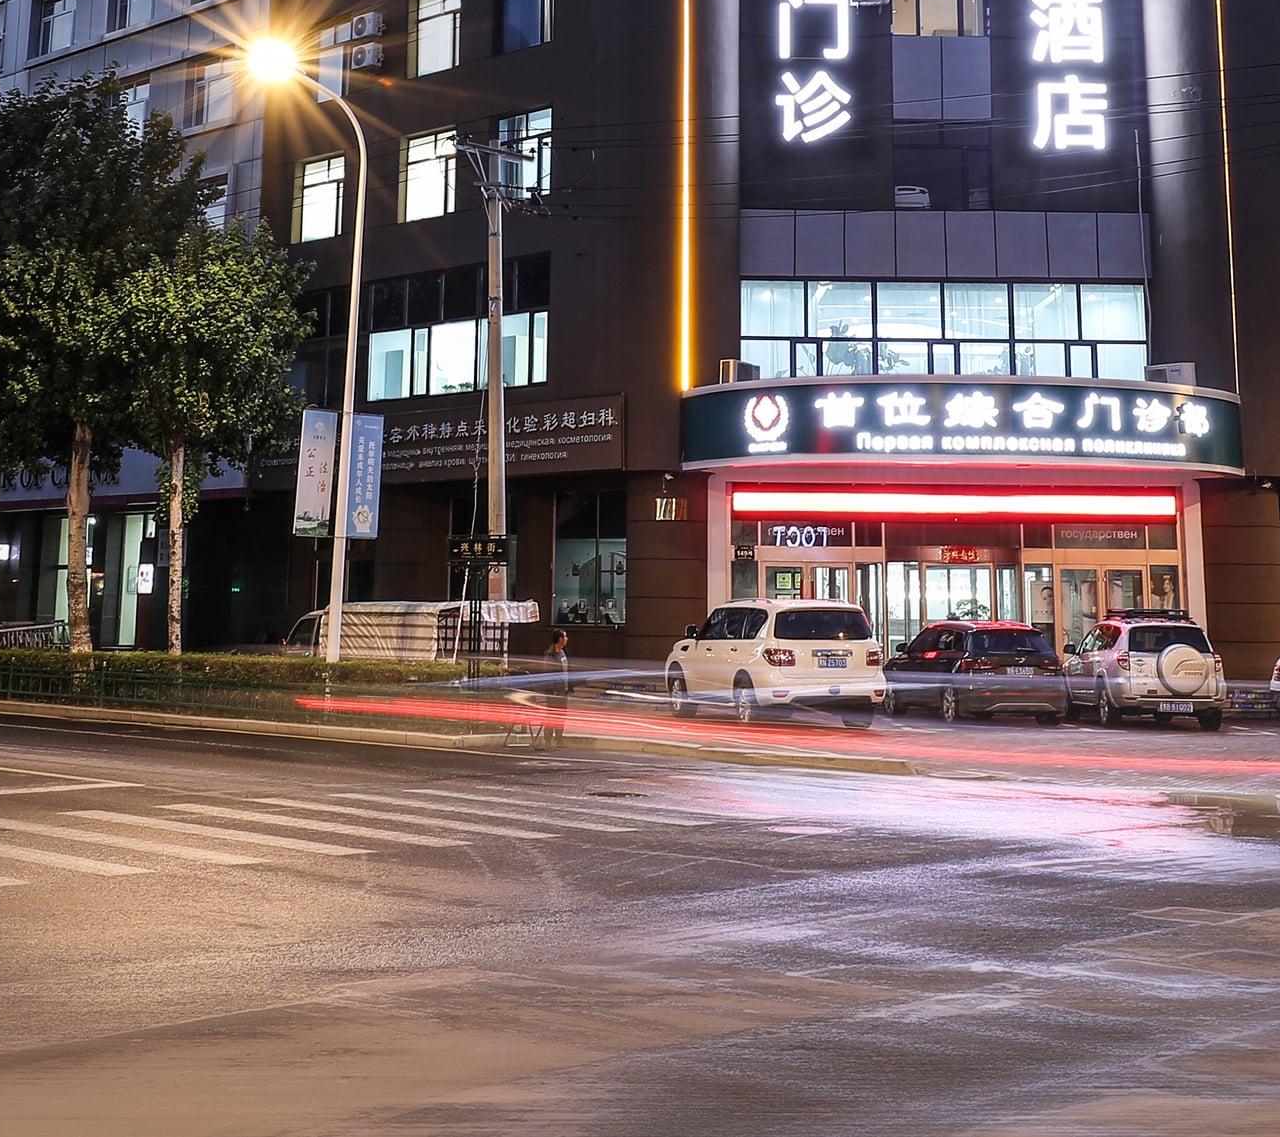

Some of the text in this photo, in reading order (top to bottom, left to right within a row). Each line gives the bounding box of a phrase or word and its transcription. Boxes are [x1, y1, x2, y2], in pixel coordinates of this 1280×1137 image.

[814, 391, 1210, 438] 首位综合门诊部
[856, 431, 934, 453] Первая
[941, 434, 1076, 452] комплексная
[305, 447, 317, 478] 公正
[317, 462, 329, 493] 法治
[1060, 528, 1138, 542] государствен
